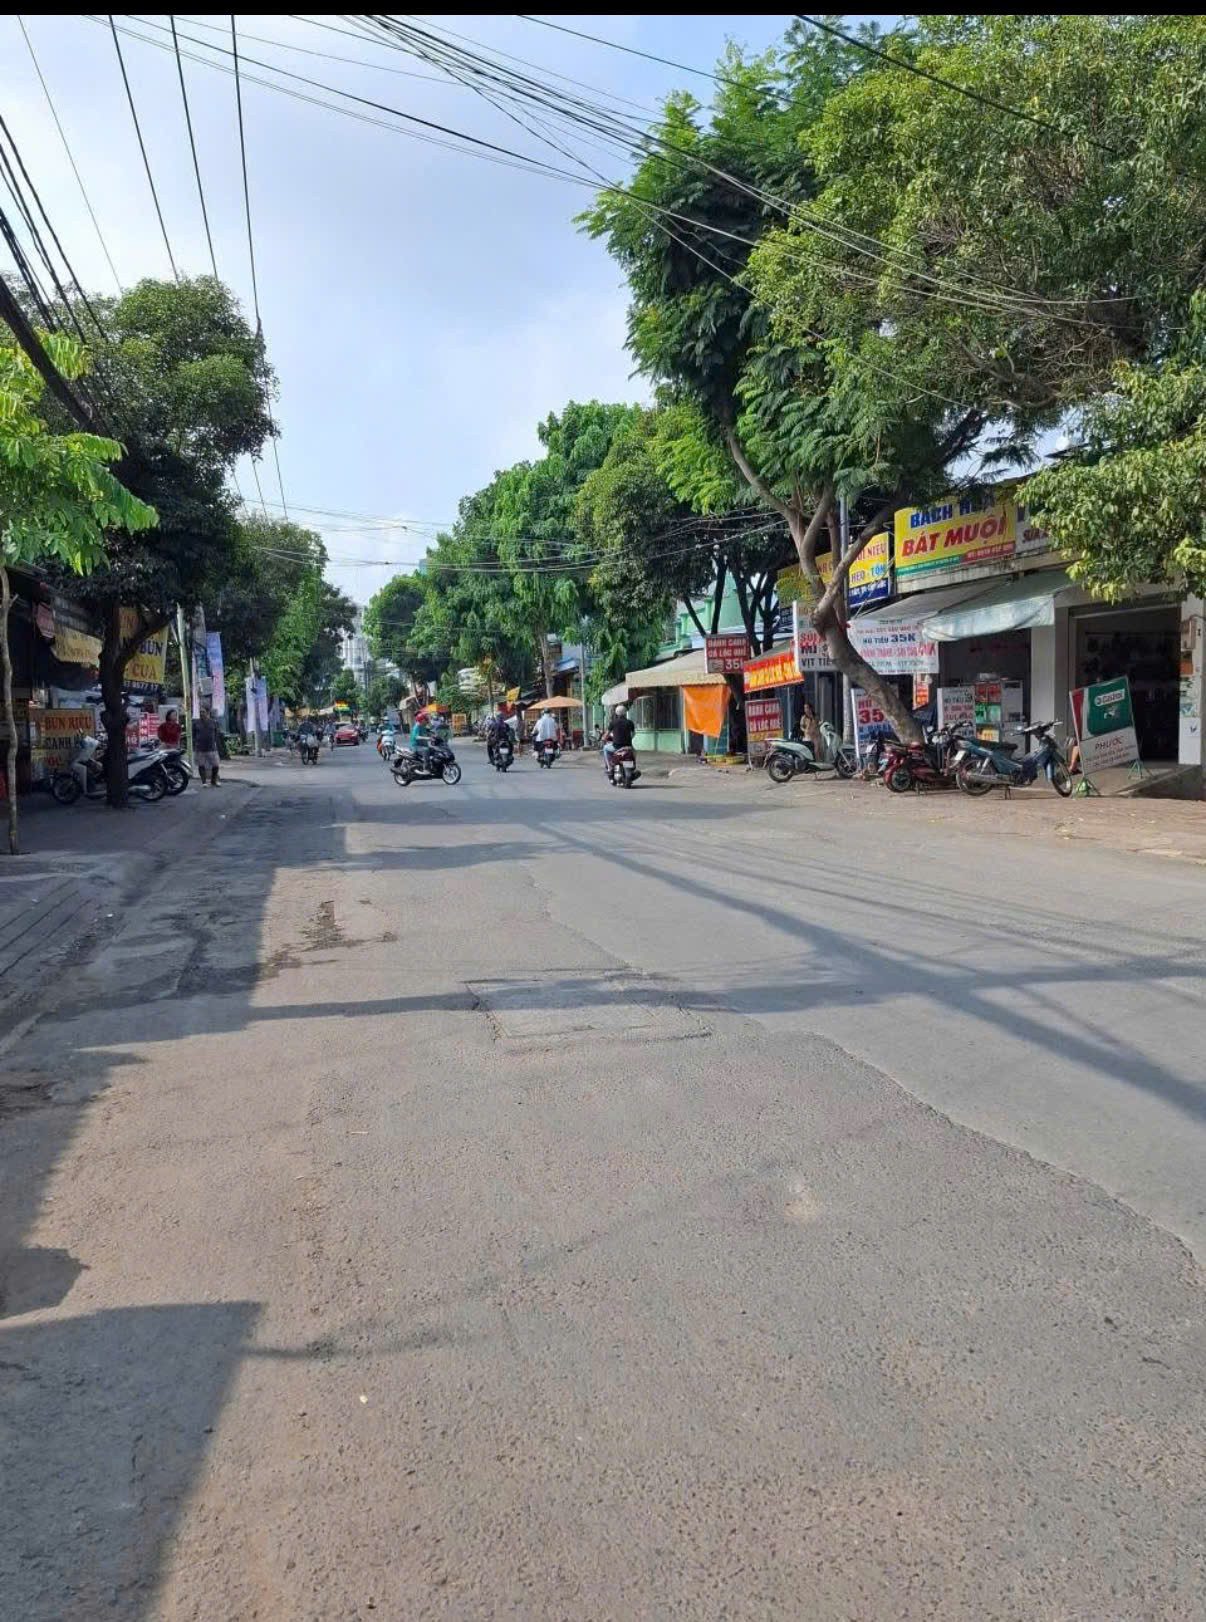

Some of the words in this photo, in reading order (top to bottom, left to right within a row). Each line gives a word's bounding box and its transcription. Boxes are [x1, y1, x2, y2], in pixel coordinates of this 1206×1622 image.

[901, 530, 940, 557] BÁT
[890, 632, 917, 643] 35K
[801, 658, 815, 668] VỊT
